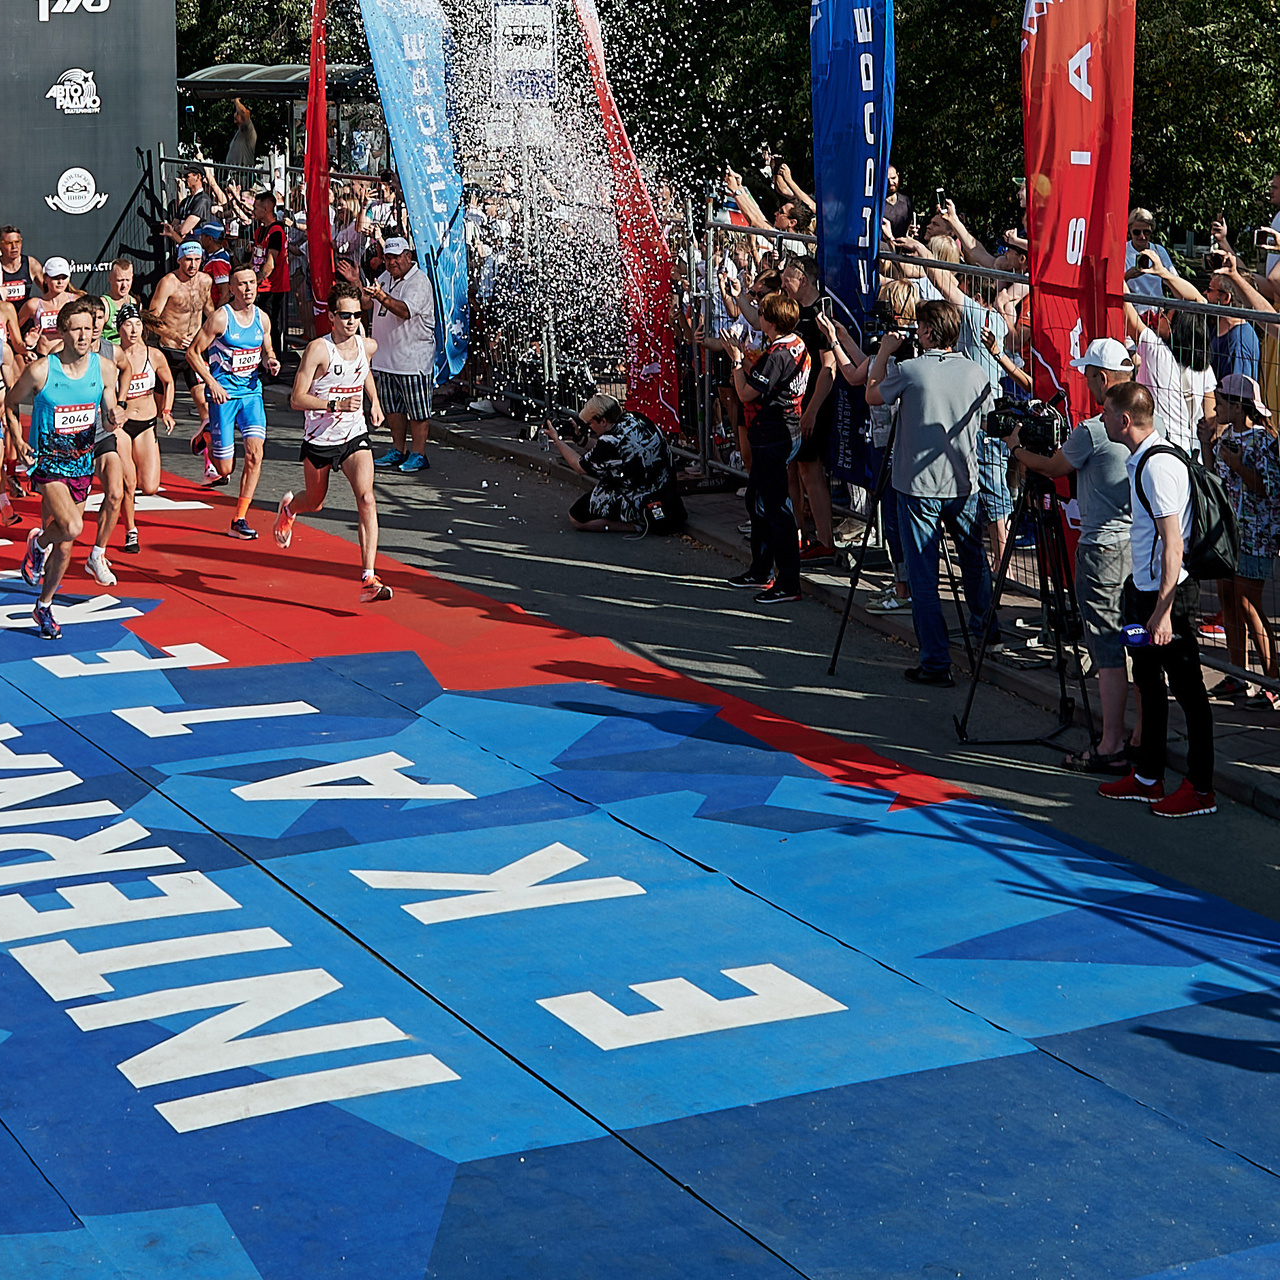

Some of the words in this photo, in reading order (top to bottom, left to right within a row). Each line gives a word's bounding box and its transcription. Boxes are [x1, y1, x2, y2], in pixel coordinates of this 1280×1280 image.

[237, 355, 257, 366] 1207
[128, 382, 146, 393] 031
[61, 413, 90, 425] 2046
